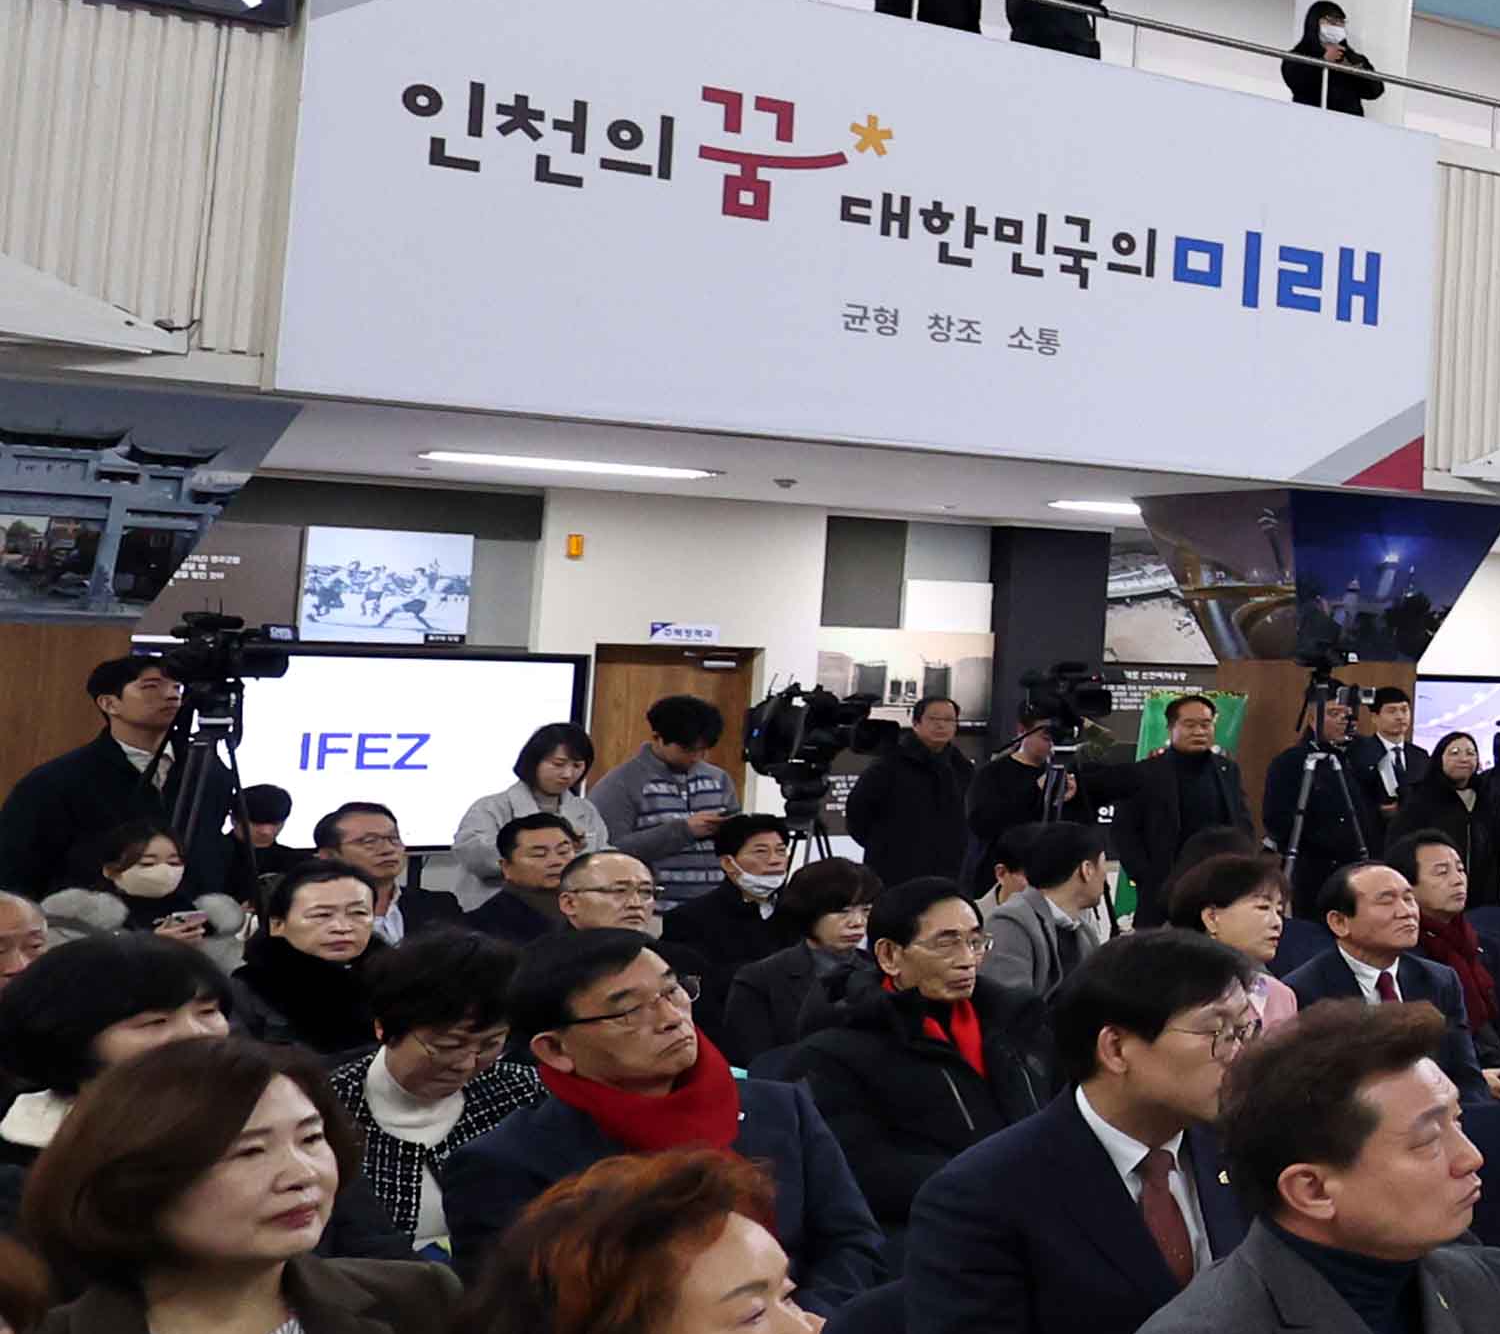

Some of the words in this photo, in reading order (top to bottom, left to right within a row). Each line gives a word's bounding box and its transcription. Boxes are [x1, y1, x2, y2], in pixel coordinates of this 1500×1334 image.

[401, 81, 675, 188] 인천의
[698, 85, 849, 222] 꿈
[839, 192, 1157, 290] 대한민국의
[1172, 230, 1382, 327] 미래
[841, 302, 900, 338] 균형
[926, 312, 983, 346] 창조
[1007, 324, 1061, 358] 소통
[300, 732, 429, 771] IFEZ
